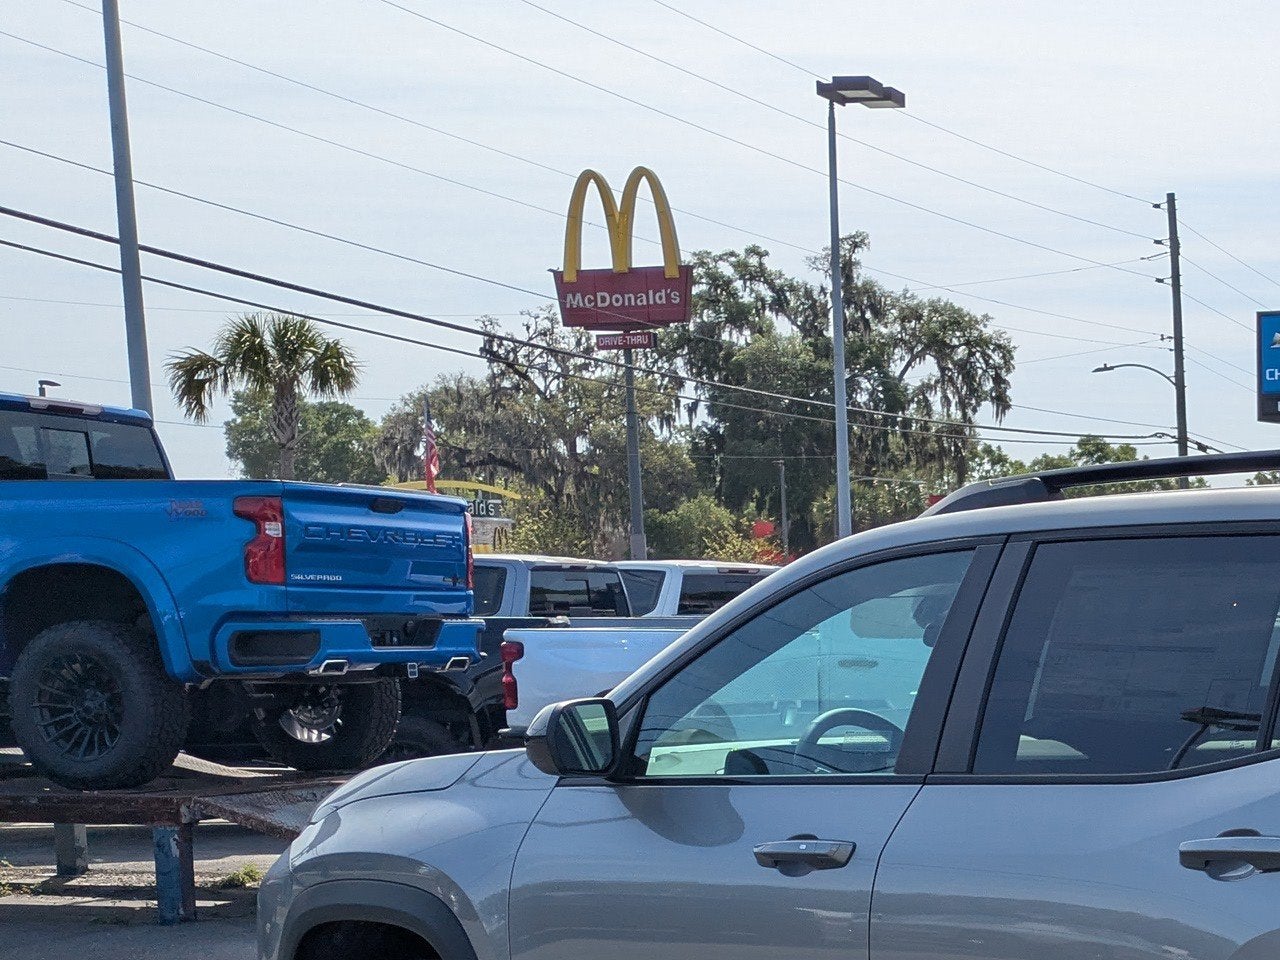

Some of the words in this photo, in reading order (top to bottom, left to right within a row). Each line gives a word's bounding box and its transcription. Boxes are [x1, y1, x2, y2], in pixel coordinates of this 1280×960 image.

[566, 289, 681, 309] McDonald's
[598, 334, 649, 346] DRIVE-THRU
[304, 526, 464, 548] CHEVROLET
[290, 573, 343, 581] SILVERADO
